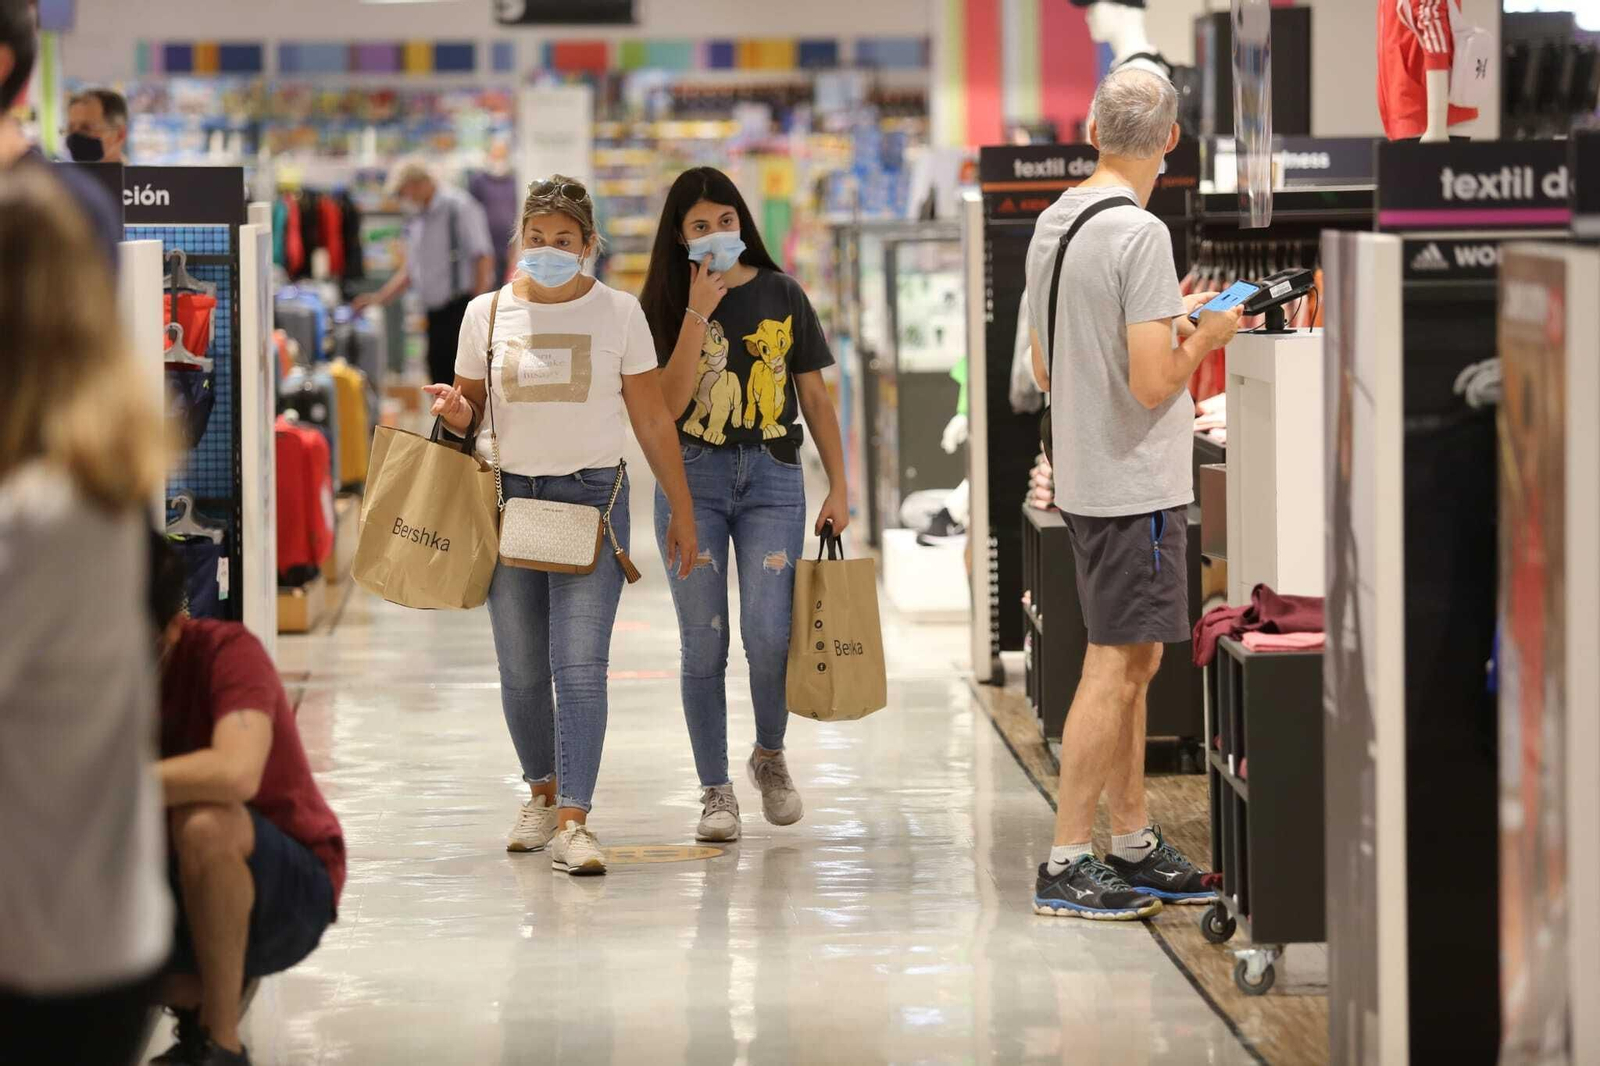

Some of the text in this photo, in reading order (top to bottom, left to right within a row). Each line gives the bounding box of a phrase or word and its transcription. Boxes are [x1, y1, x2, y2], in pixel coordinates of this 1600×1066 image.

[1013, 158, 1065, 178] textil
[123, 184, 170, 206] ción
[1440, 166, 1576, 200] textil d
[392, 517, 451, 552] Bershka
